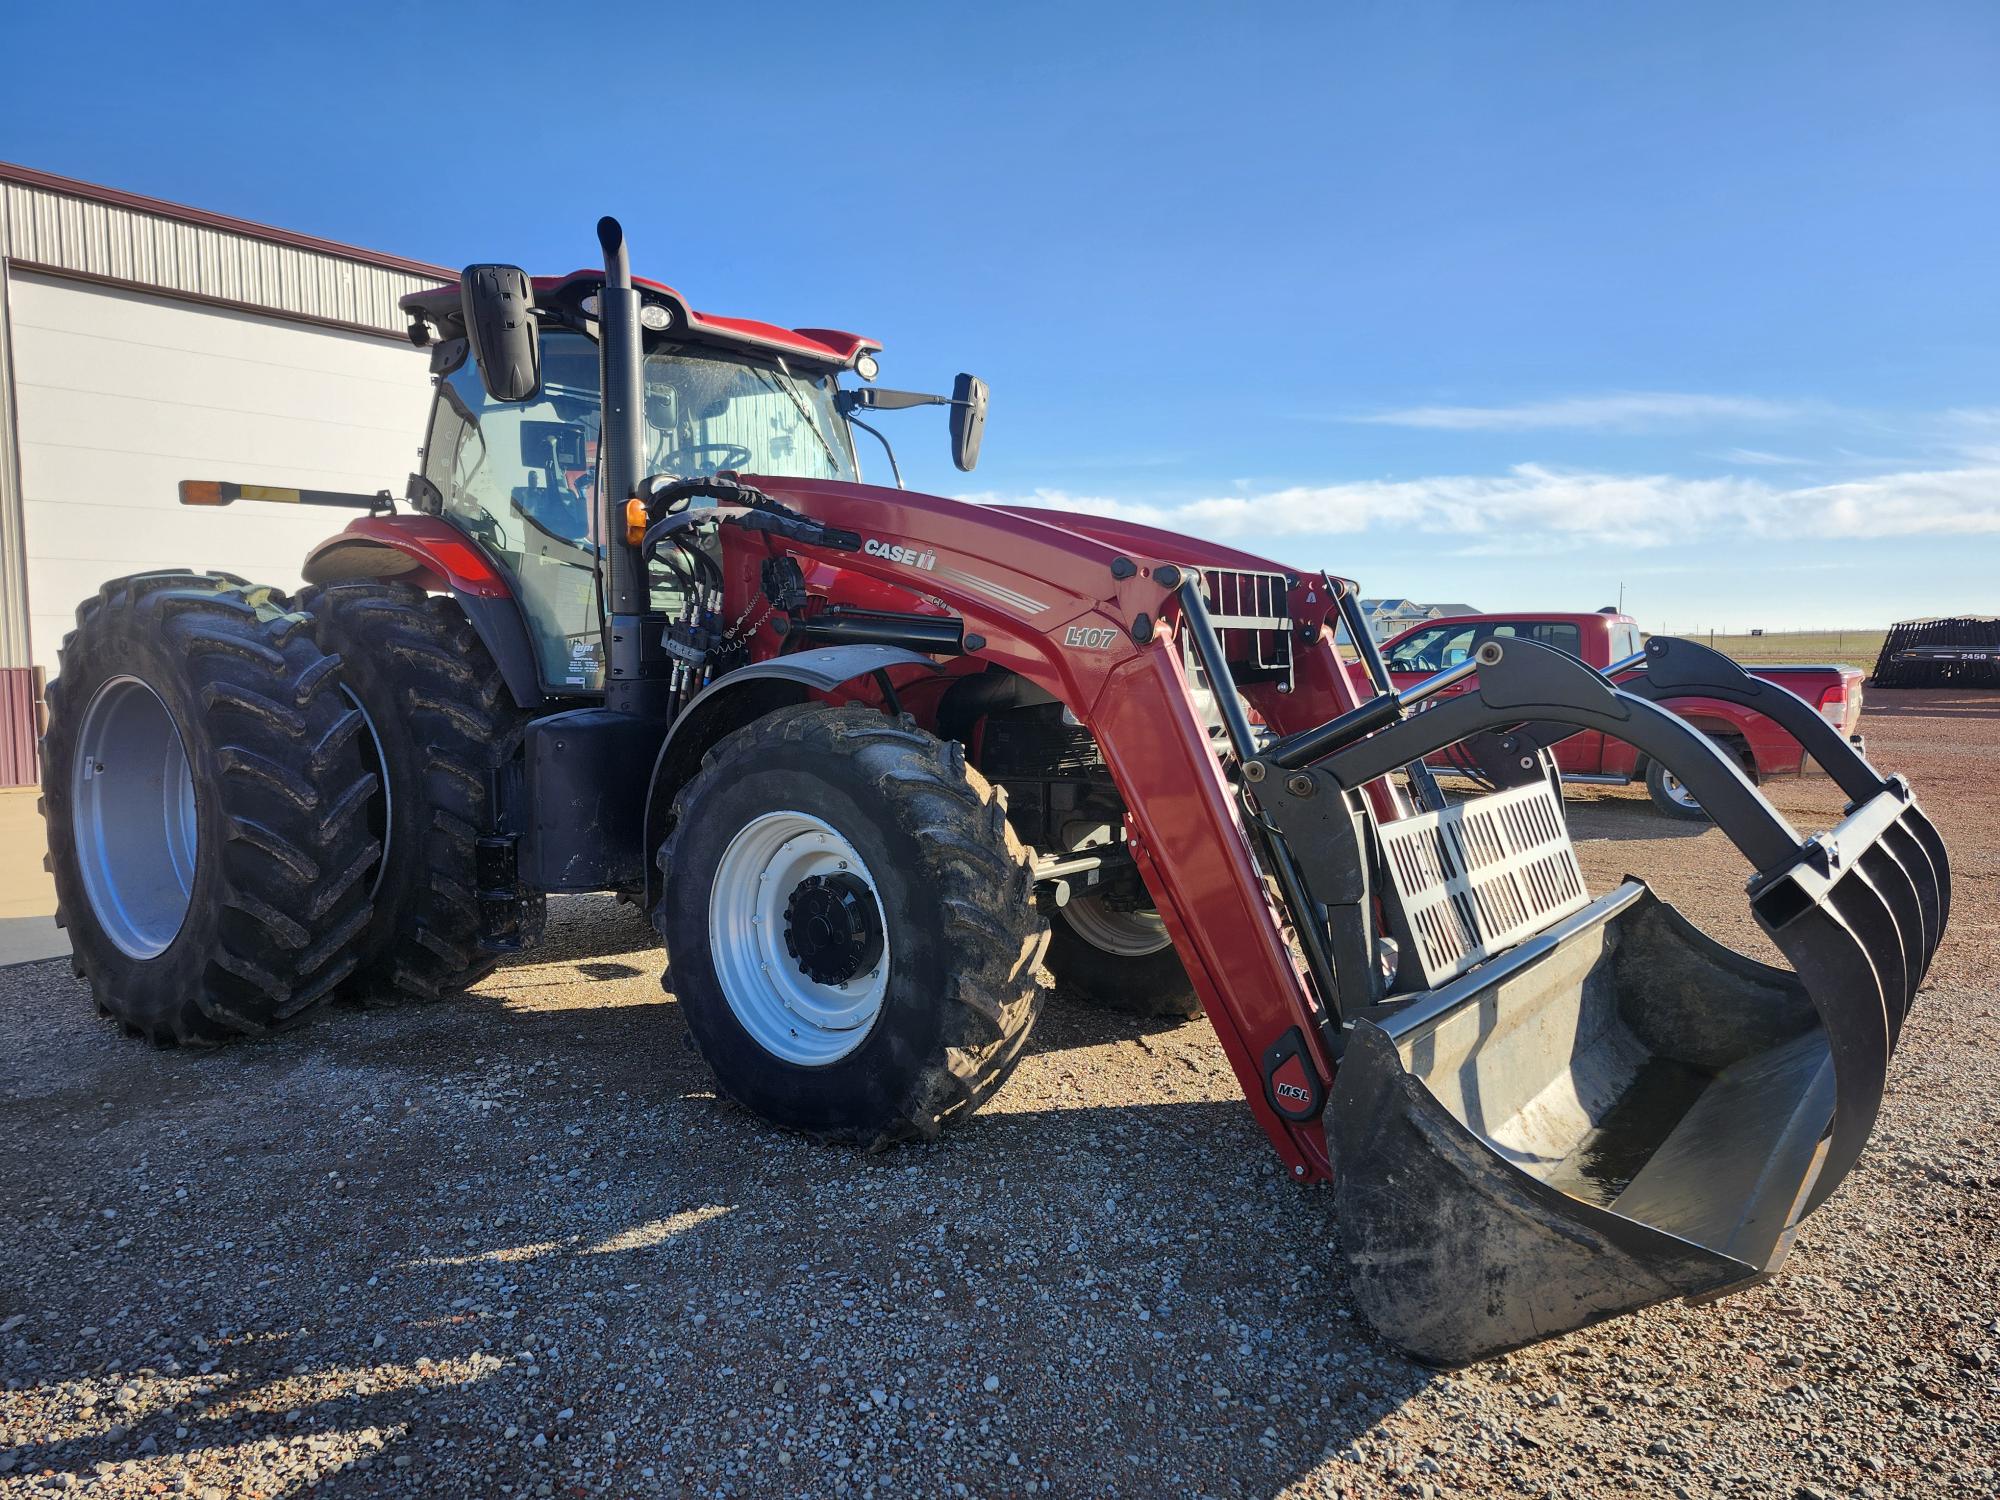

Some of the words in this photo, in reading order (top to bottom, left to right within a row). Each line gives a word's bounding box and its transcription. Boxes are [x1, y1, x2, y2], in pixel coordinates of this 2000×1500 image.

[864, 539, 918, 566] CASE
[1064, 626, 1119, 649] L107
[1277, 1083, 1310, 1103] MSL
